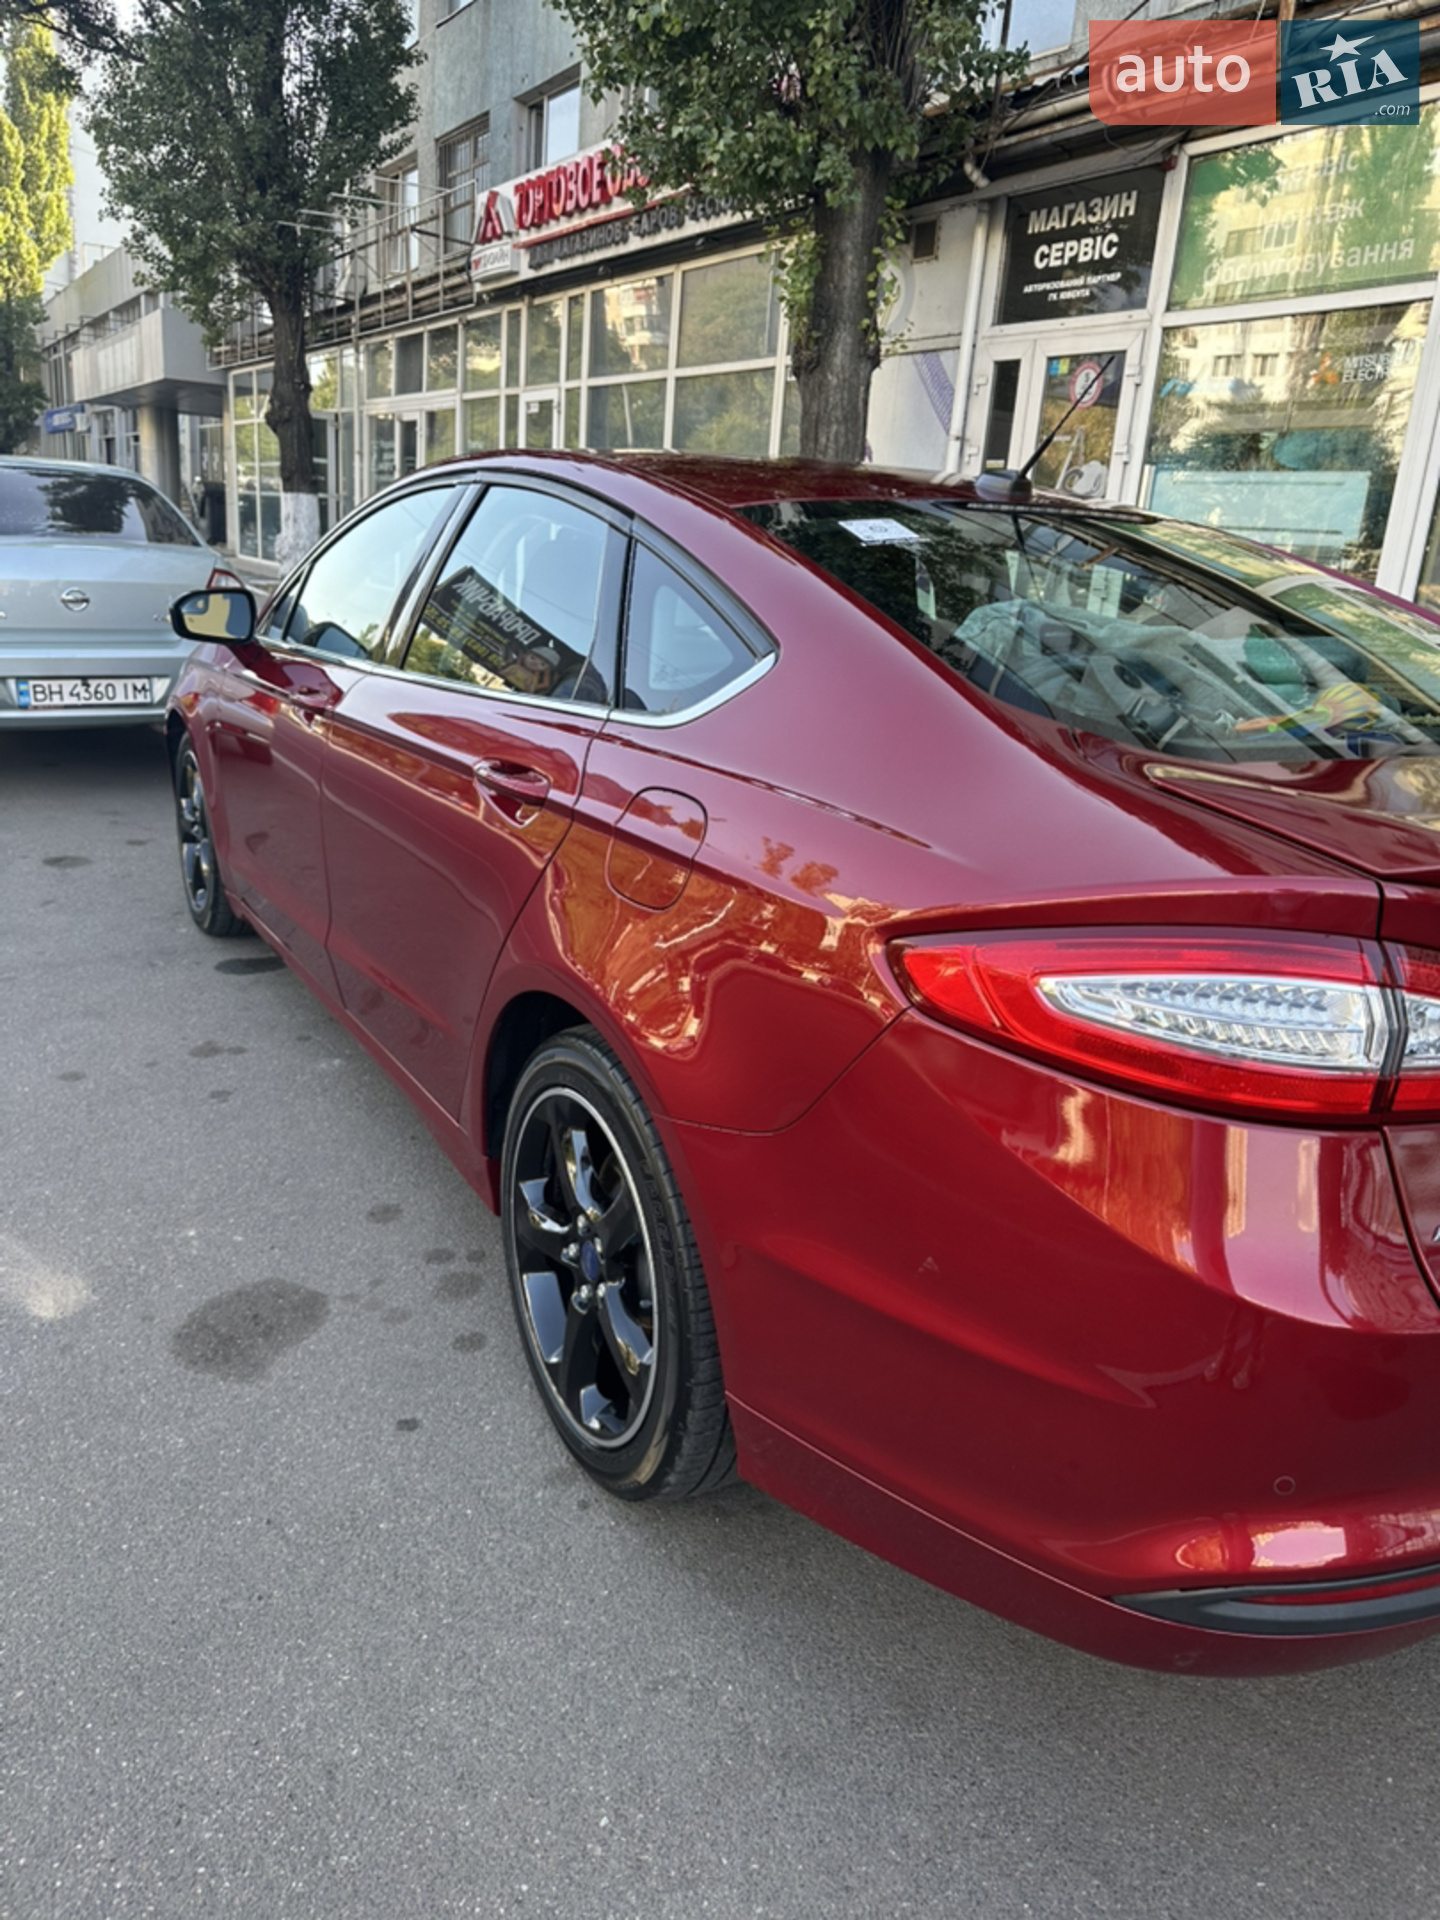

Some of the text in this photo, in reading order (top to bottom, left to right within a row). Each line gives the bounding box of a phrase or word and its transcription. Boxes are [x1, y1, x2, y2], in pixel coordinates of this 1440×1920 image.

[514, 151, 609, 231] ТОРГОВОЕ
[1027, 189, 1138, 235] МАГАЗИН
[1034, 233, 1119, 270] СЕРВІС
[32, 682, 149, 702] BH 4360 IM
